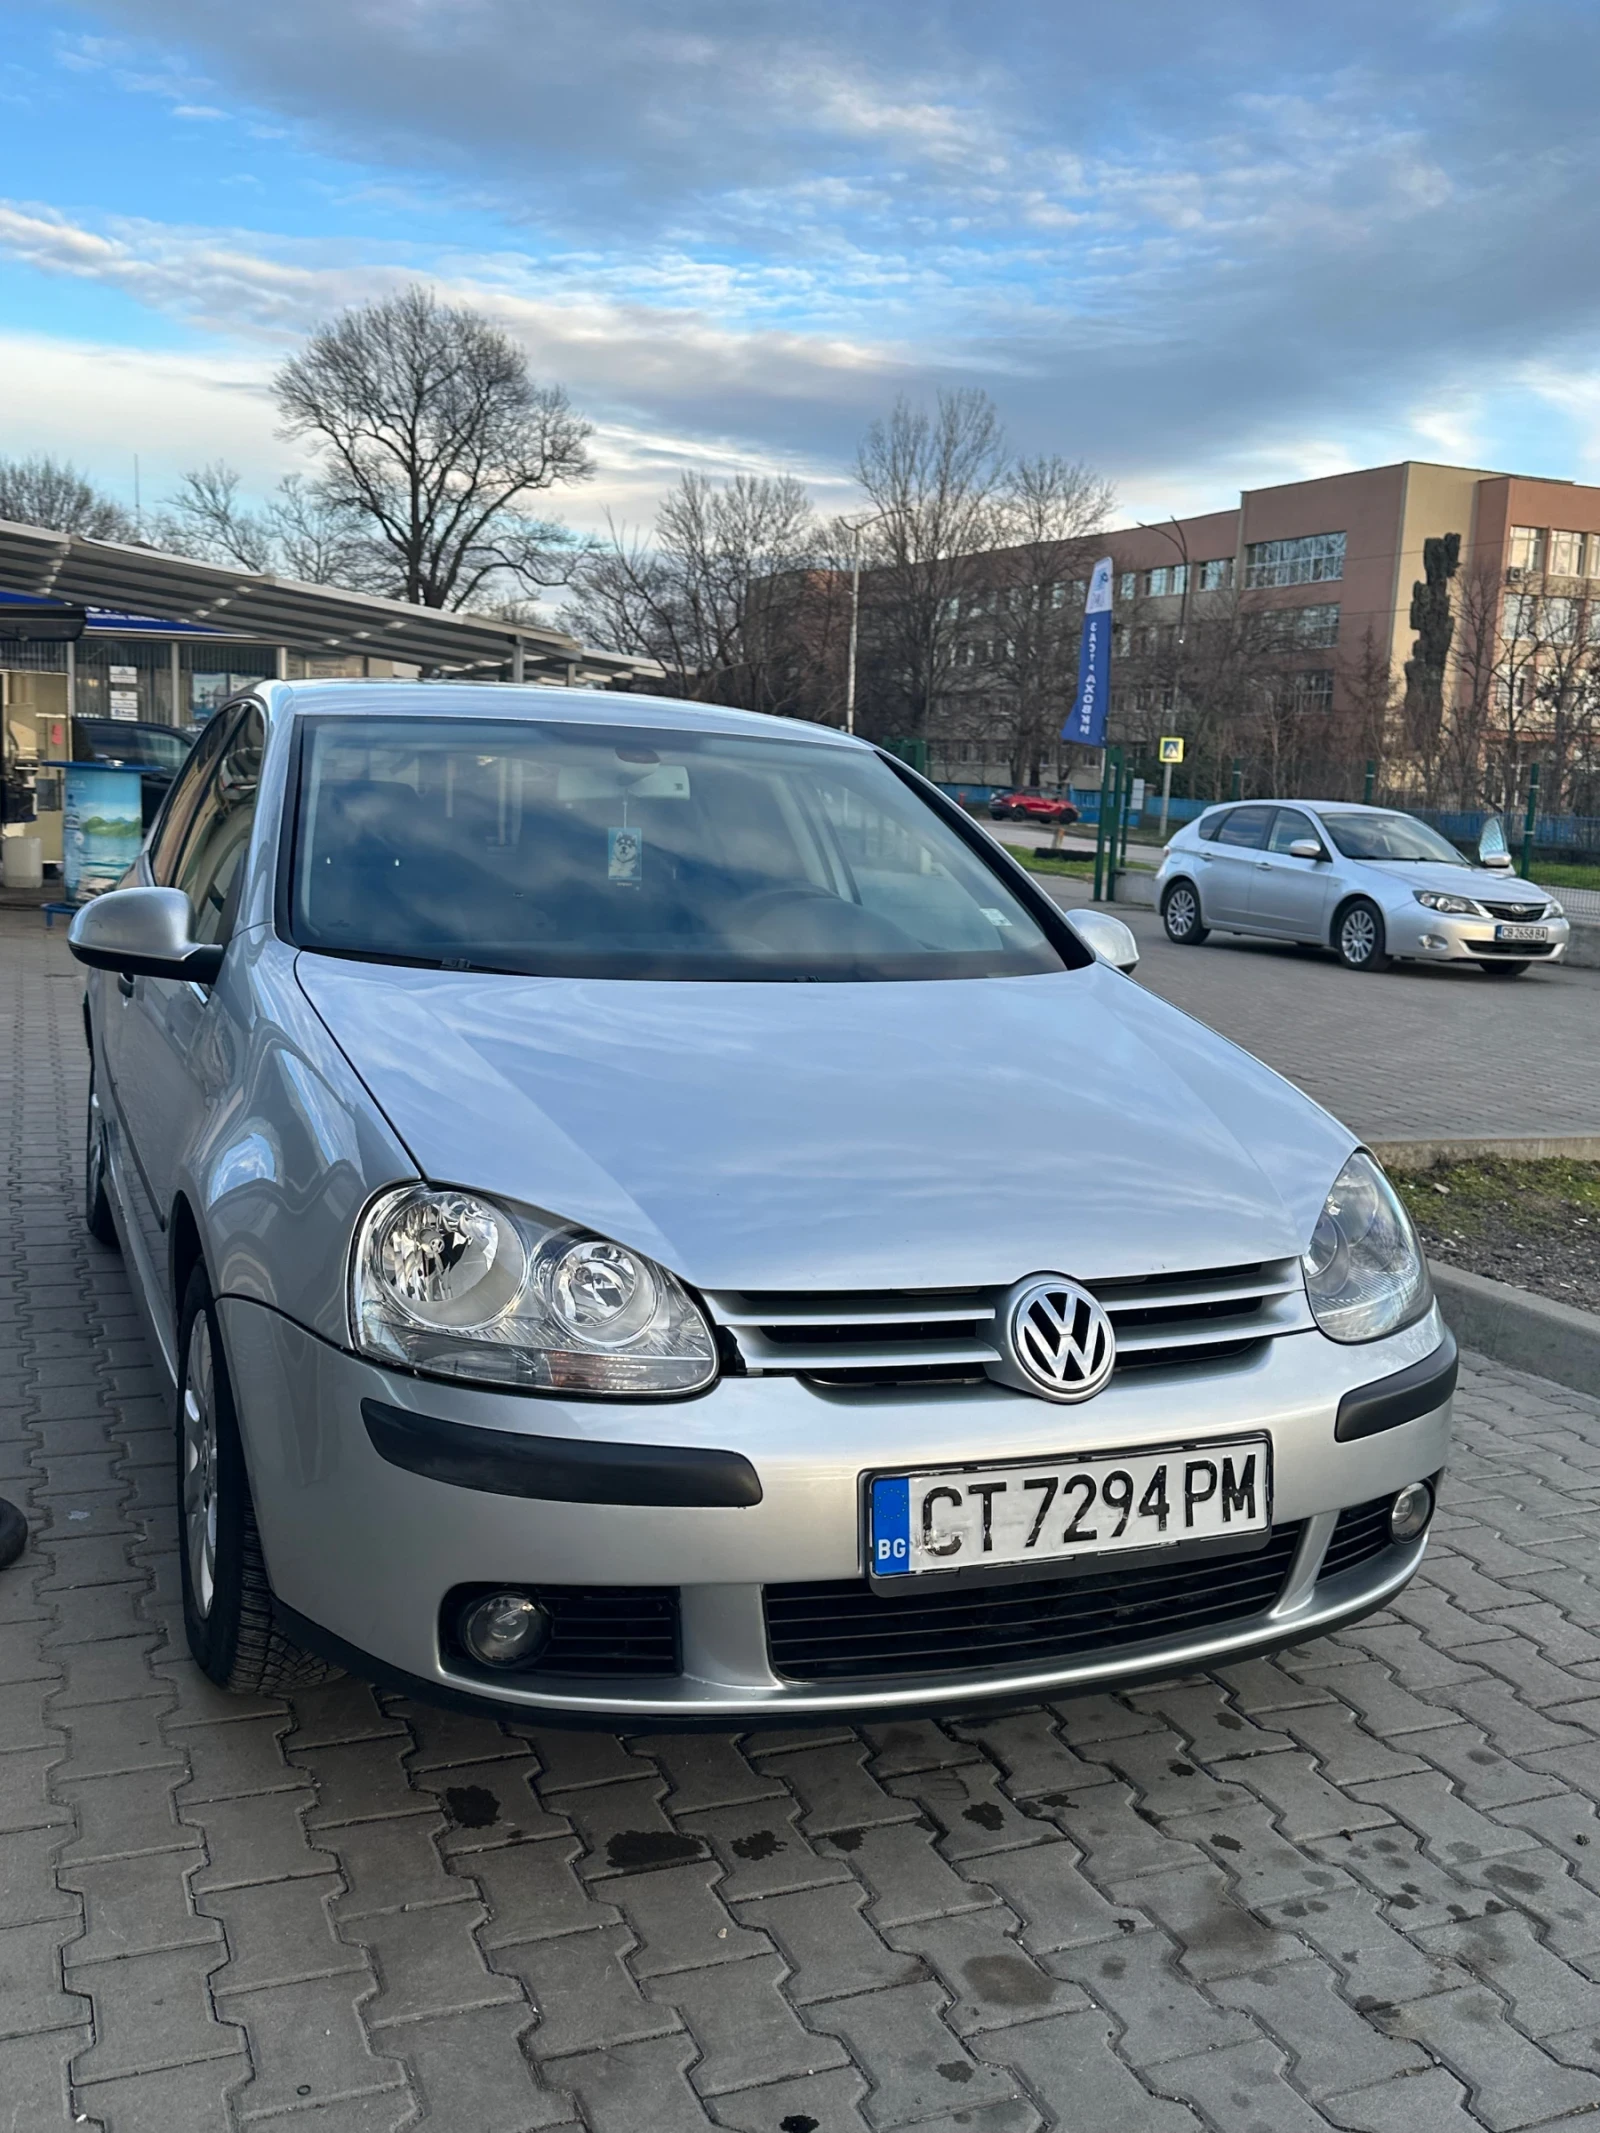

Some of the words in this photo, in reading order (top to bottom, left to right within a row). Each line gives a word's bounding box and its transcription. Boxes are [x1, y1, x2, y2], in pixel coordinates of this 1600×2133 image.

[922, 1481, 1008, 1556] CT
[1024, 1465, 1171, 1549] 7294
[1185, 1454, 1256, 1528] PM
[878, 1539, 906, 1561] BG
